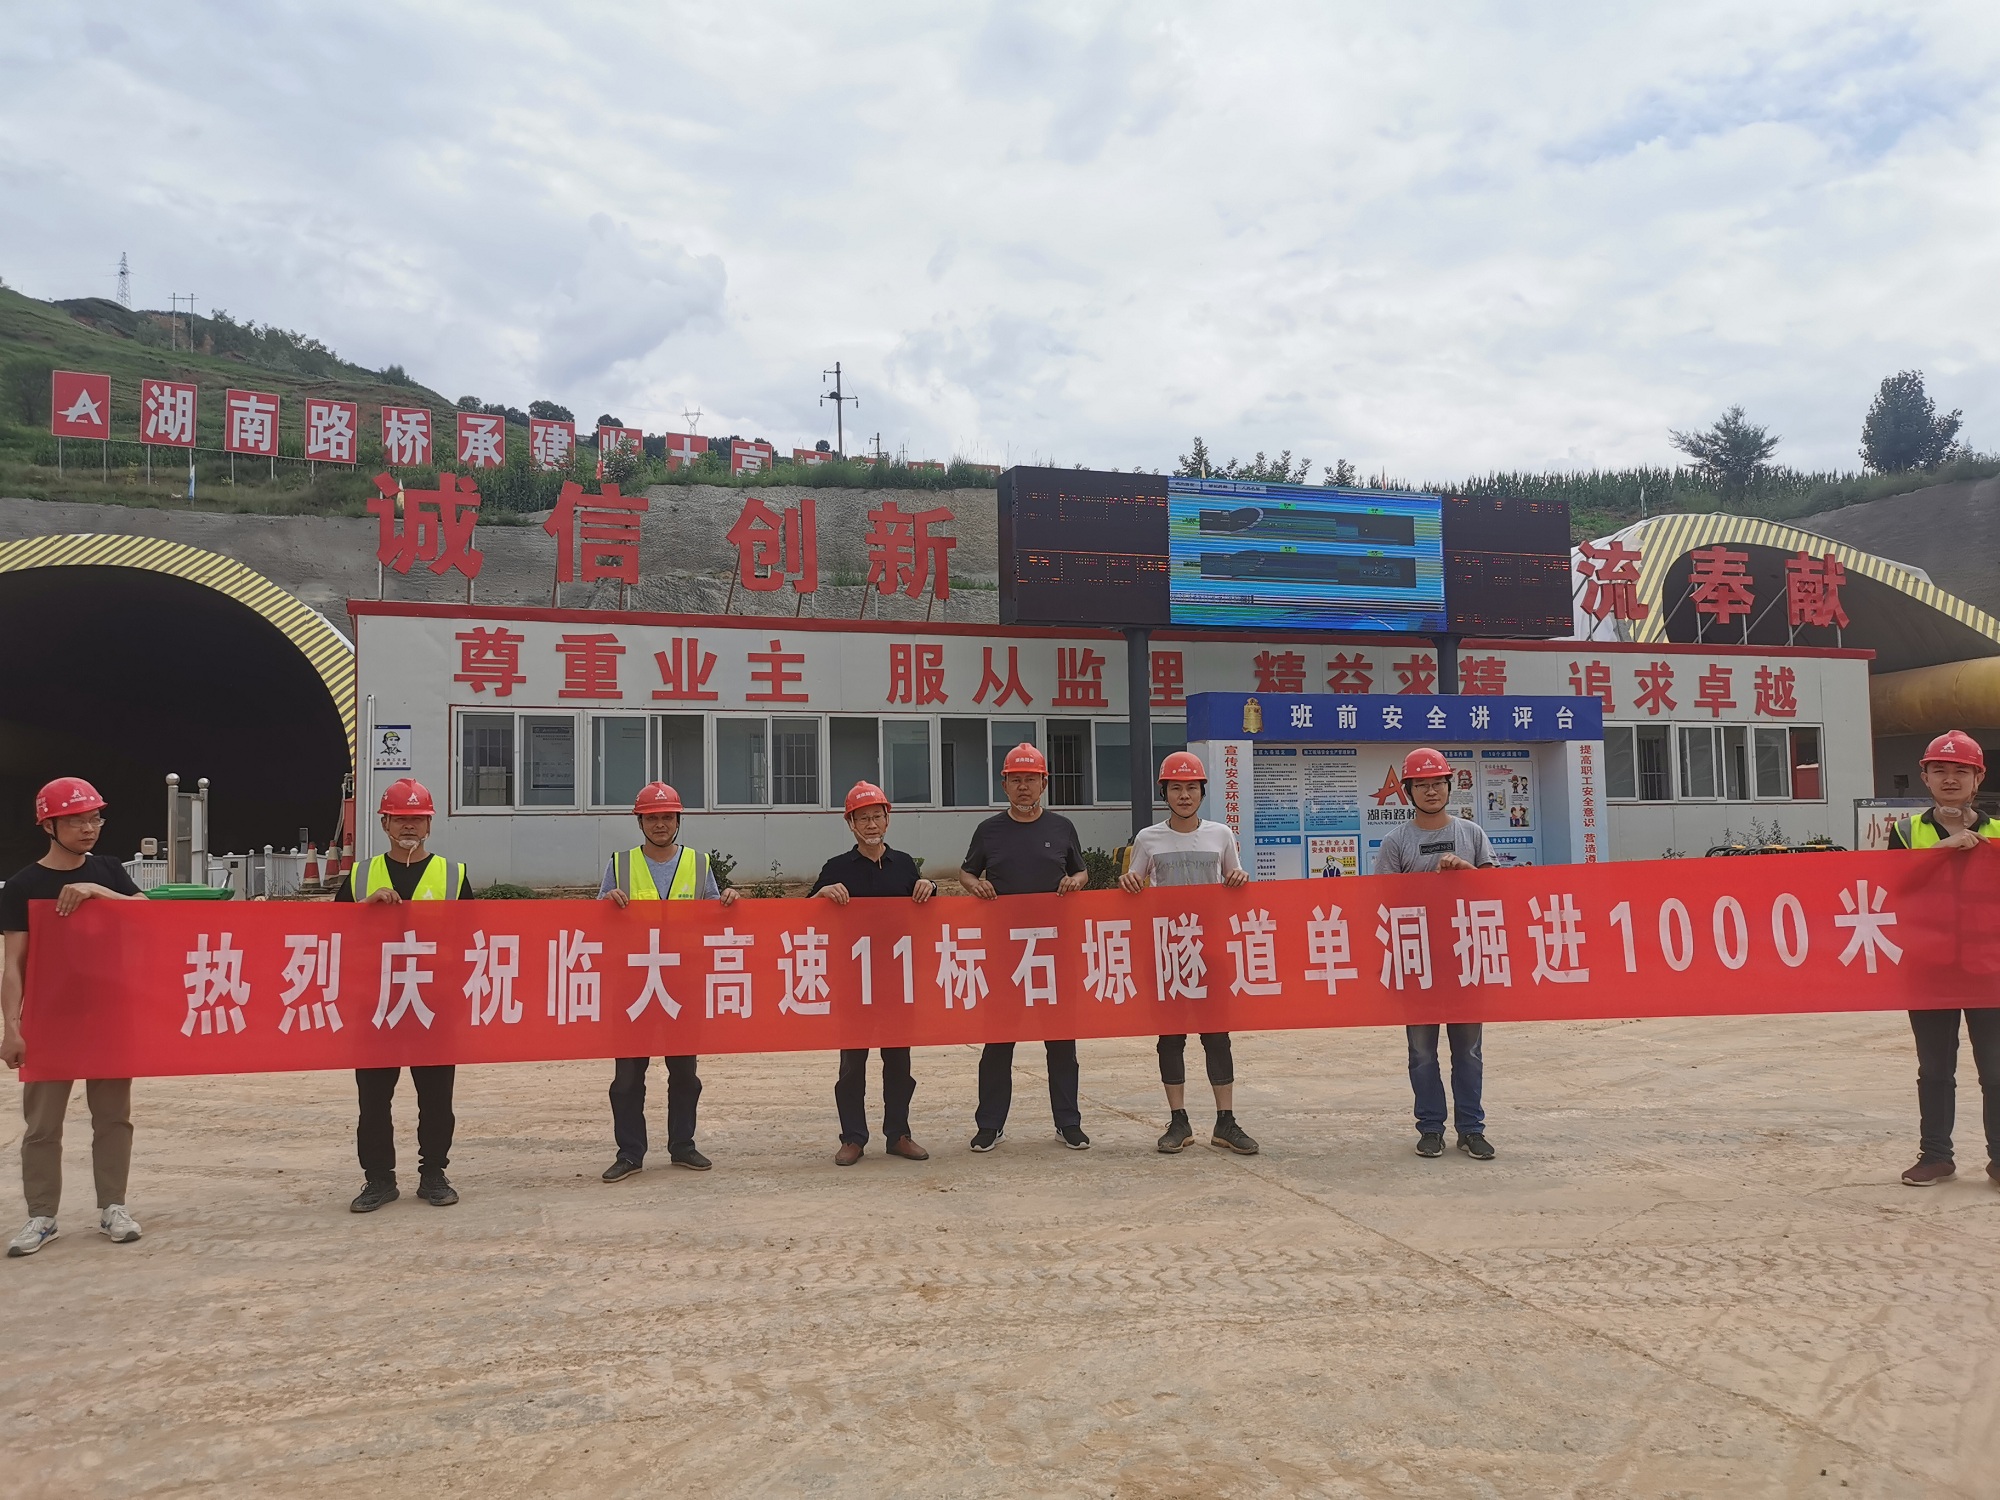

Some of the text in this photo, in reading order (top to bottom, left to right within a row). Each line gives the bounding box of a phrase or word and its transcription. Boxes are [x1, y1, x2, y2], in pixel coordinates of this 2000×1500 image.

[367, 472, 957, 600] 诚信创新
[453, 626, 1798, 718] 尊重业主 服从监理 精益求精 追求卓越
[1290, 704, 1575, 730] 班前安全讲评台
[1580, 745, 1596, 828] 提高职工安全意识
[1311, 839, 1355, 847] 施工作业人员
[1311, 846, 1356, 854] 安全着装示意图
[180, 879, 1904, 1038] 热烈庆祝临大高速11标石塬隧道单洞掘进1000米
